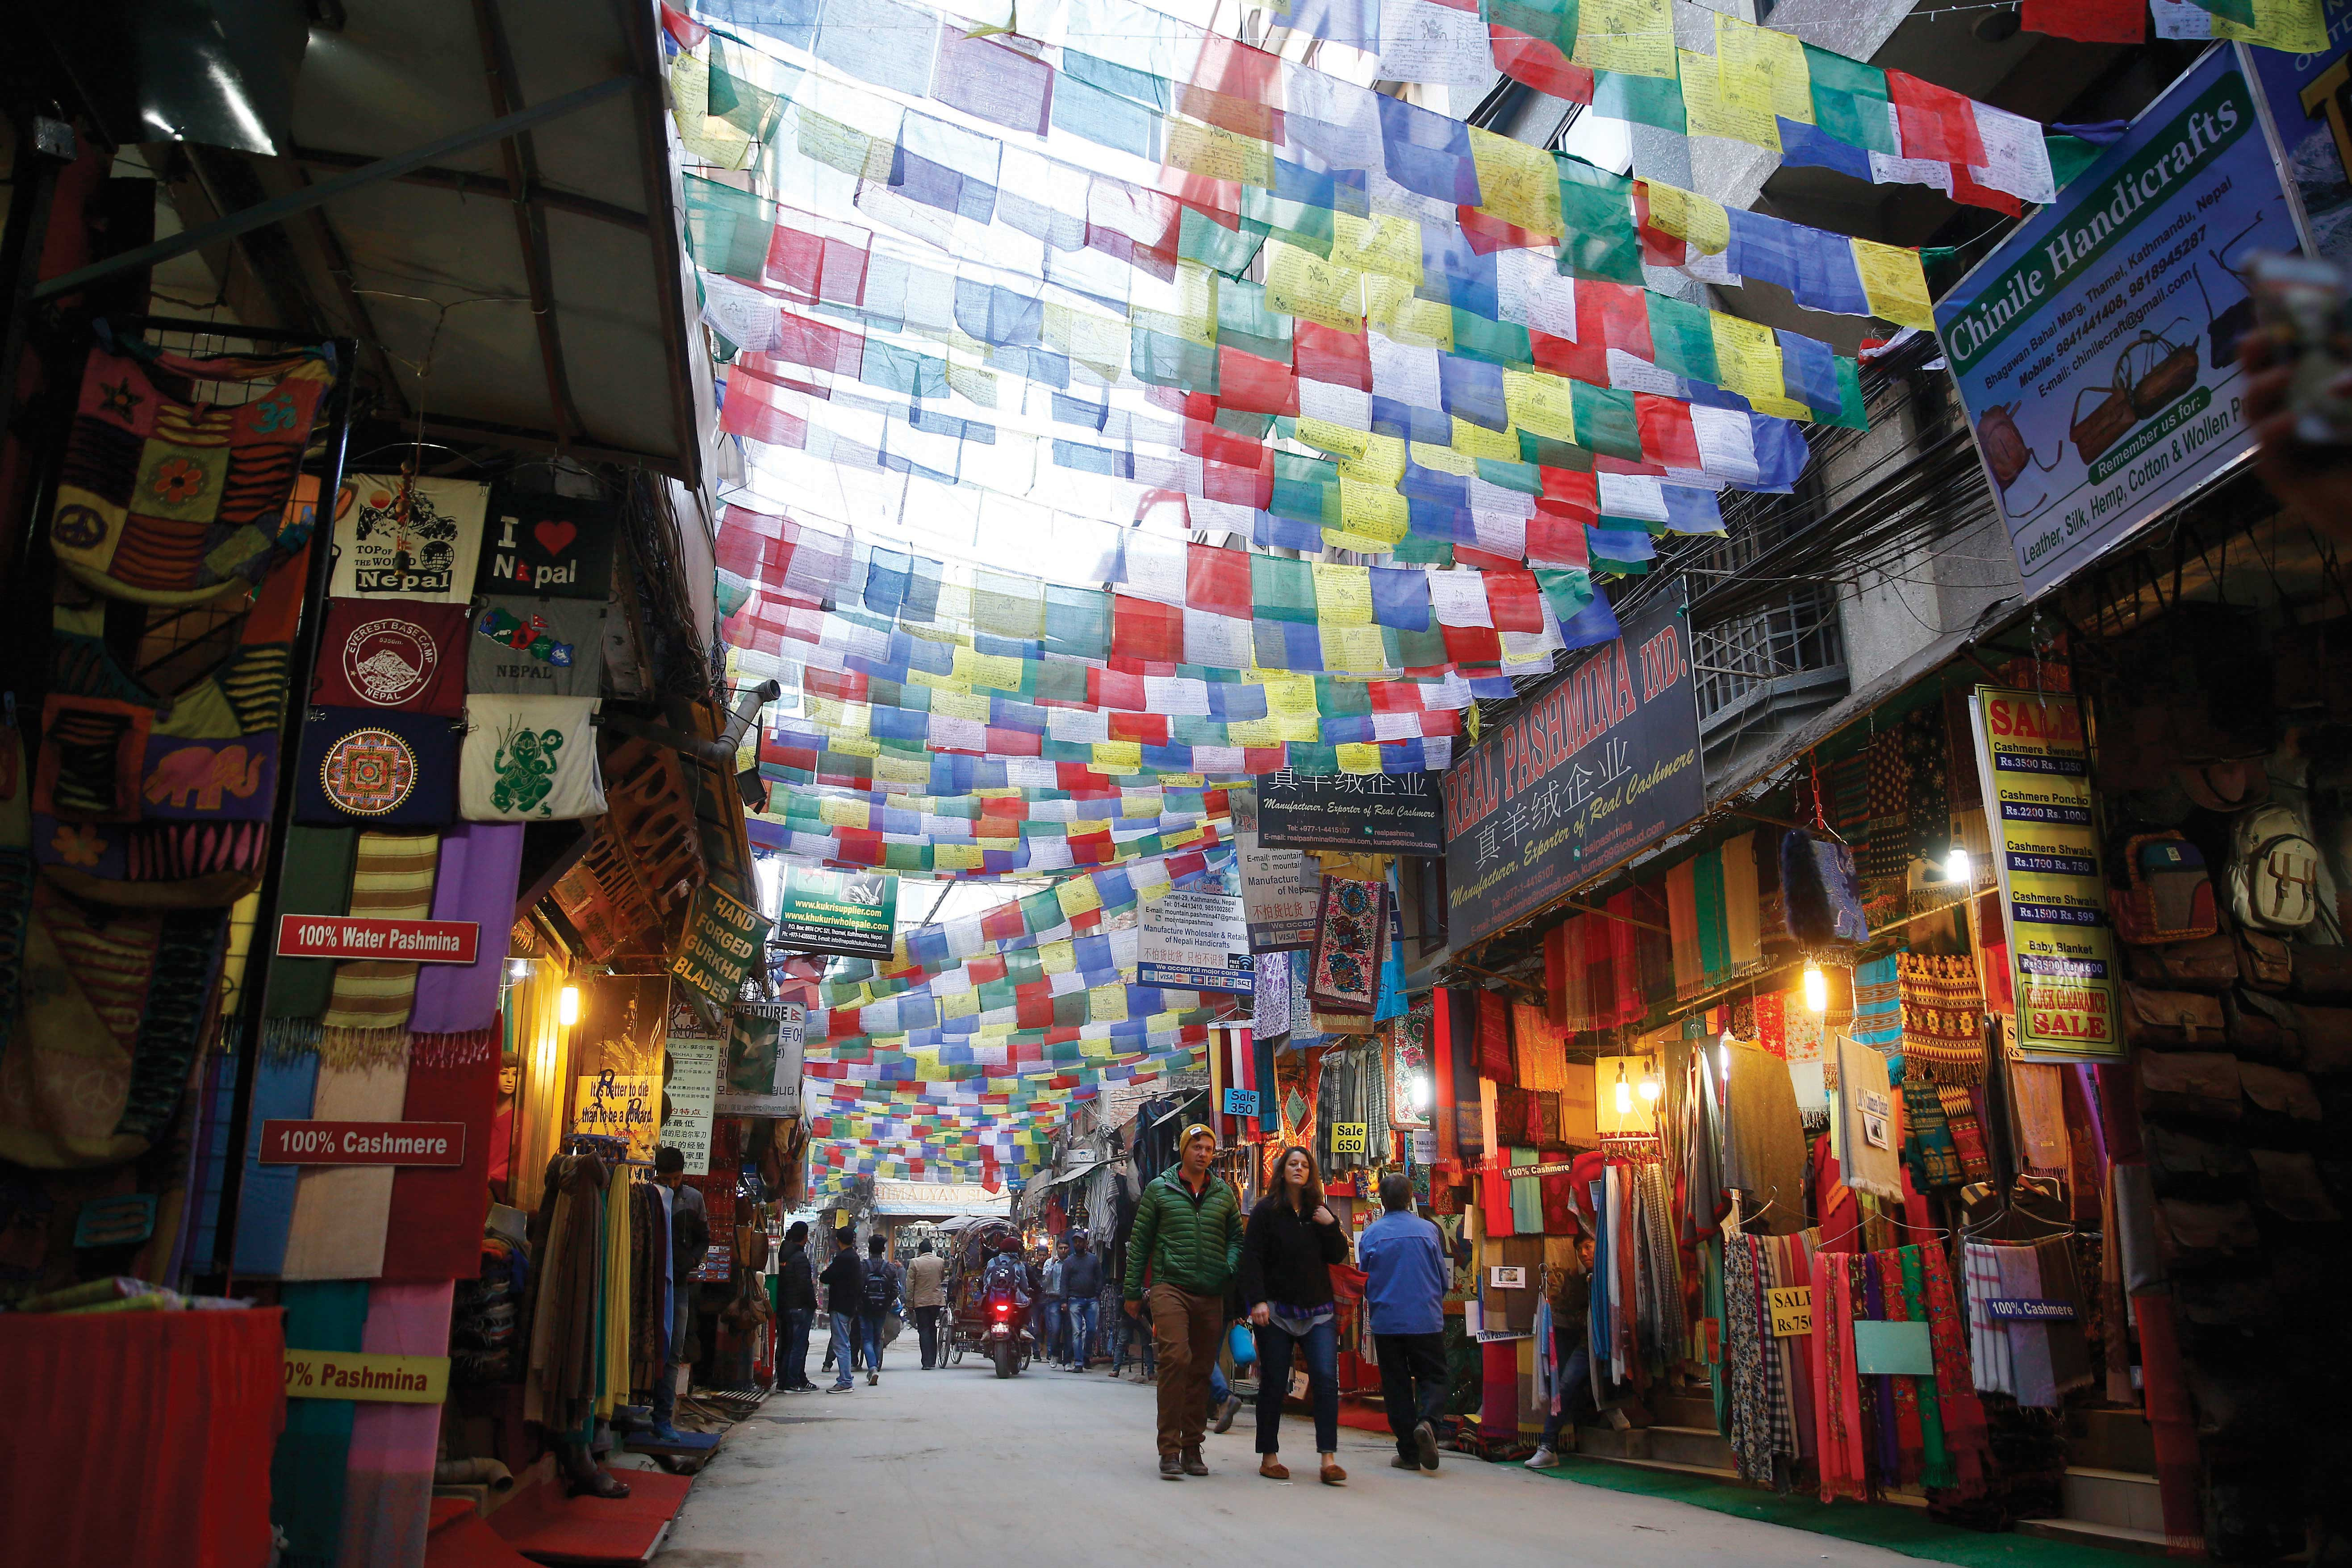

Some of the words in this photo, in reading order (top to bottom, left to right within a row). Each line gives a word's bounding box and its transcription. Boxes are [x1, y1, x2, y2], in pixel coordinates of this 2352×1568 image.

[1949, 269, 2045, 361] Chinile
[2044, 99, 2238, 280] Handicrafts
[1984, 347, 2036, 389] Bhagawan
[2030, 321, 2057, 349] Bahal
[2057, 304, 2086, 328] Marg,
[2085, 265, 2128, 302] Thamel,
[2127, 211, 2196, 268] Kathmandu,
[2195, 176, 2232, 213] Nepal
[2018, 351, 2055, 388] Mobile:
[2129, 224, 2206, 297] 9818945287
[2038, 366, 2072, 397] E-mail:
[2072, 268, 2192, 370] chinilecraft@gmail.com
[2098, 427, 2158, 477] Remember
[2161, 415, 2176, 431] us
[2178, 397, 2201, 425] for:
[2022, 527, 2064, 566] Leather,
[2065, 507, 2089, 536] Silk,
[2090, 484, 2127, 519] Hemp,
[2128, 453, 2169, 492] Cotton
[2172, 439, 2182, 463] &
[2182, 412, 2229, 454] Wollen
[498, 516, 519, 548] I
[356, 545, 382, 554] TOP
[372, 558, 416, 566] WOD
[493, 554, 576, 588] Npal
[358, 571, 448, 591] Nepal
[349, 623, 387, 653] EVEREST
[391, 622, 420, 636] BASE
[419, 636, 433, 663] CAMP
[497, 665, 551, 678] NEPAL
[365, 687, 401, 700] NEPAL
[1990, 699, 2081, 740] SALE
[1443, 741, 1500, 844] REAL
[1501, 635, 1637, 802] PASHMINA
[1640, 625, 1687, 704] IND.
[1994, 742, 2043, 754] Cashmere
[2046, 745, 2084, 757] Sweater
[2041, 760, 2055, 769] Rs.
[2060, 762, 2081, 772] 1250
[1475, 737, 1632, 871] 真羊绒企业
[2001, 790, 2049, 802] Cashmere
[2052, 793, 2088, 805] Poncho
[1263, 798, 1323, 812] Manufacturer,
[1328, 802, 1360, 814] Exporter
[1363, 808, 1371, 817] of
[1375, 805, 1394, 815] Real
[1397, 806, 1435, 818] Cashmere
[2046, 809, 2061, 818] Rs.
[2065, 811, 2086, 820] 1000
[1450, 861, 1518, 909] Manufacturer,
[1524, 828, 1569, 866] Exporter
[1573, 810, 1586, 838] of
[1590, 786, 1622, 825] Real
[1625, 748, 1694, 805] Cashmere
[1287, 835, 1372, 846] realpashmina@hotmail.com,
[1374, 839, 1437, 848] kumar99@icloud.com
[2007, 840, 2055, 853] Cashmere
[2059, 845, 2093, 856] Shwals
[2055, 860, 2069, 870] Rs.
[2072, 861, 2089, 871] 750
[1194, 878, 1224, 893] Center
[1191, 896, 1220, 905] Kathmandu,
[2013, 891, 2061, 904] Cashmere
[2064, 895, 2098, 906] Shwals
[713, 897, 756, 931] HAND
[795, 900, 881, 917] www.kukrisupplier.com
[1205, 905, 1234, 913] 9851002867
[2060, 910, 2074, 920] Rs.
[2078, 912, 2094, 921] 599
[785, 912, 889, 931] www.khukuriwholesale.com
[1165, 916, 1213, 926] mountainpashmina
[298, 925, 337, 946] 100%
[343, 927, 386, 948] Water
[389, 929, 460, 951] Pashmina
[697, 912, 753, 958] FORGED
[847, 931, 870, 939] Kathmandu,
[1144, 924, 1182, 934] Manufacture
[1185, 928, 1220, 939] Wholesaler
[1174, 937, 1192, 945] Nepali
[1195, 939, 1230, 948] Handicrafts
[2029, 941, 2053, 953] Baby
[2057, 942, 2093, 954] Blanket
[685, 934, 741, 984] GURKHA
[2063, 962, 2077, 972] Rs.
[2080, 963, 2102, 973] 1600
[673, 956, 730, 1003] BLADES
[2026, 987, 2055, 1009] STOCK
[2057, 990, 2106, 1013] CLEARANCE
[2033, 1013, 2107, 1038] SALE
[781, 1027, 802, 1043] 투어
[590, 1081, 603, 1097] Its
[606, 1081, 627, 1097] better
[630, 1083, 635, 1097] to
[638, 1081, 649, 1097] die
[1231, 1091, 1256, 1102] Sale
[582, 1107, 597, 1123] than
[600, 1108, 606, 1123] to
[609, 1107, 617, 1122] be
[619, 1111, 623, 1122] a
[626, 1107, 653, 1123] oward.
[1231, 1103, 1253, 1114] 350
[1337, 1125, 1363, 1136] Sale
[280, 1131, 335, 1153] 100%
[343, 1132, 447, 1154] Cashmere
[1337, 1140, 1361, 1150] 650
[1508, 1167, 1529, 1177] 100%
[1531, 1163, 1569, 1175] Cashmere
[1993, 1302, 2022, 1314] 100%
[2024, 1302, 2073, 1315] Cashmere
[321, 1364, 427, 1392] Pashmina
